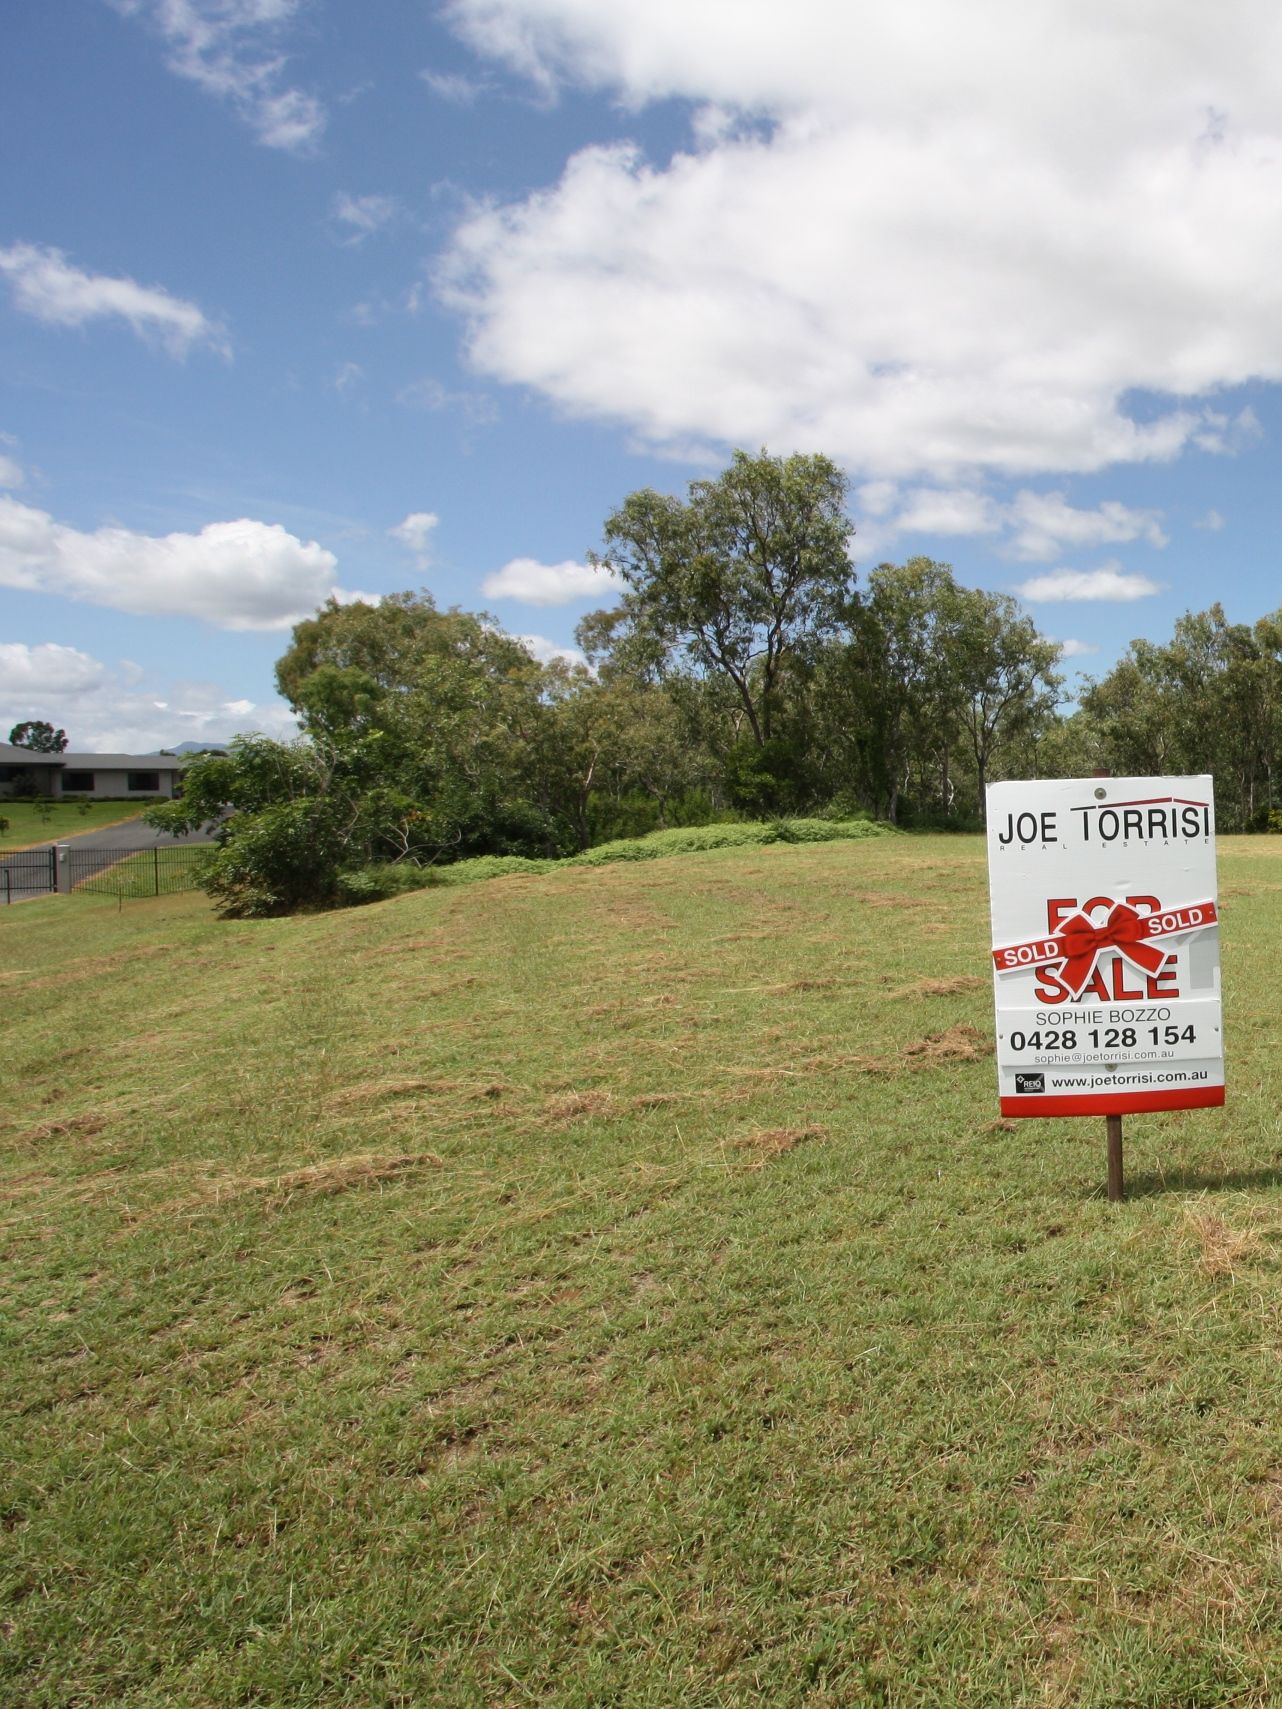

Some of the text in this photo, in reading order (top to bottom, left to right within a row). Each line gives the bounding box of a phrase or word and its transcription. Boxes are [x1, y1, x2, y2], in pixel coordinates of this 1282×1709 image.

[999, 803, 1210, 844] JOE TORRISI
[1000, 838, 1209, 851] REAL ESTATE
[1148, 907, 1204, 935] SOLD
[1003, 941, 1059, 967] SOLD
[1035, 1007, 1171, 1026] SOPHIE BOZZO
[1010, 1024, 1197, 1051] 0428 128 154
[1034, 1050, 1174, 1065] sophie@joetorrisi.com.au
[1052, 1070, 1208, 1089] www.joetorrisi.com.au
